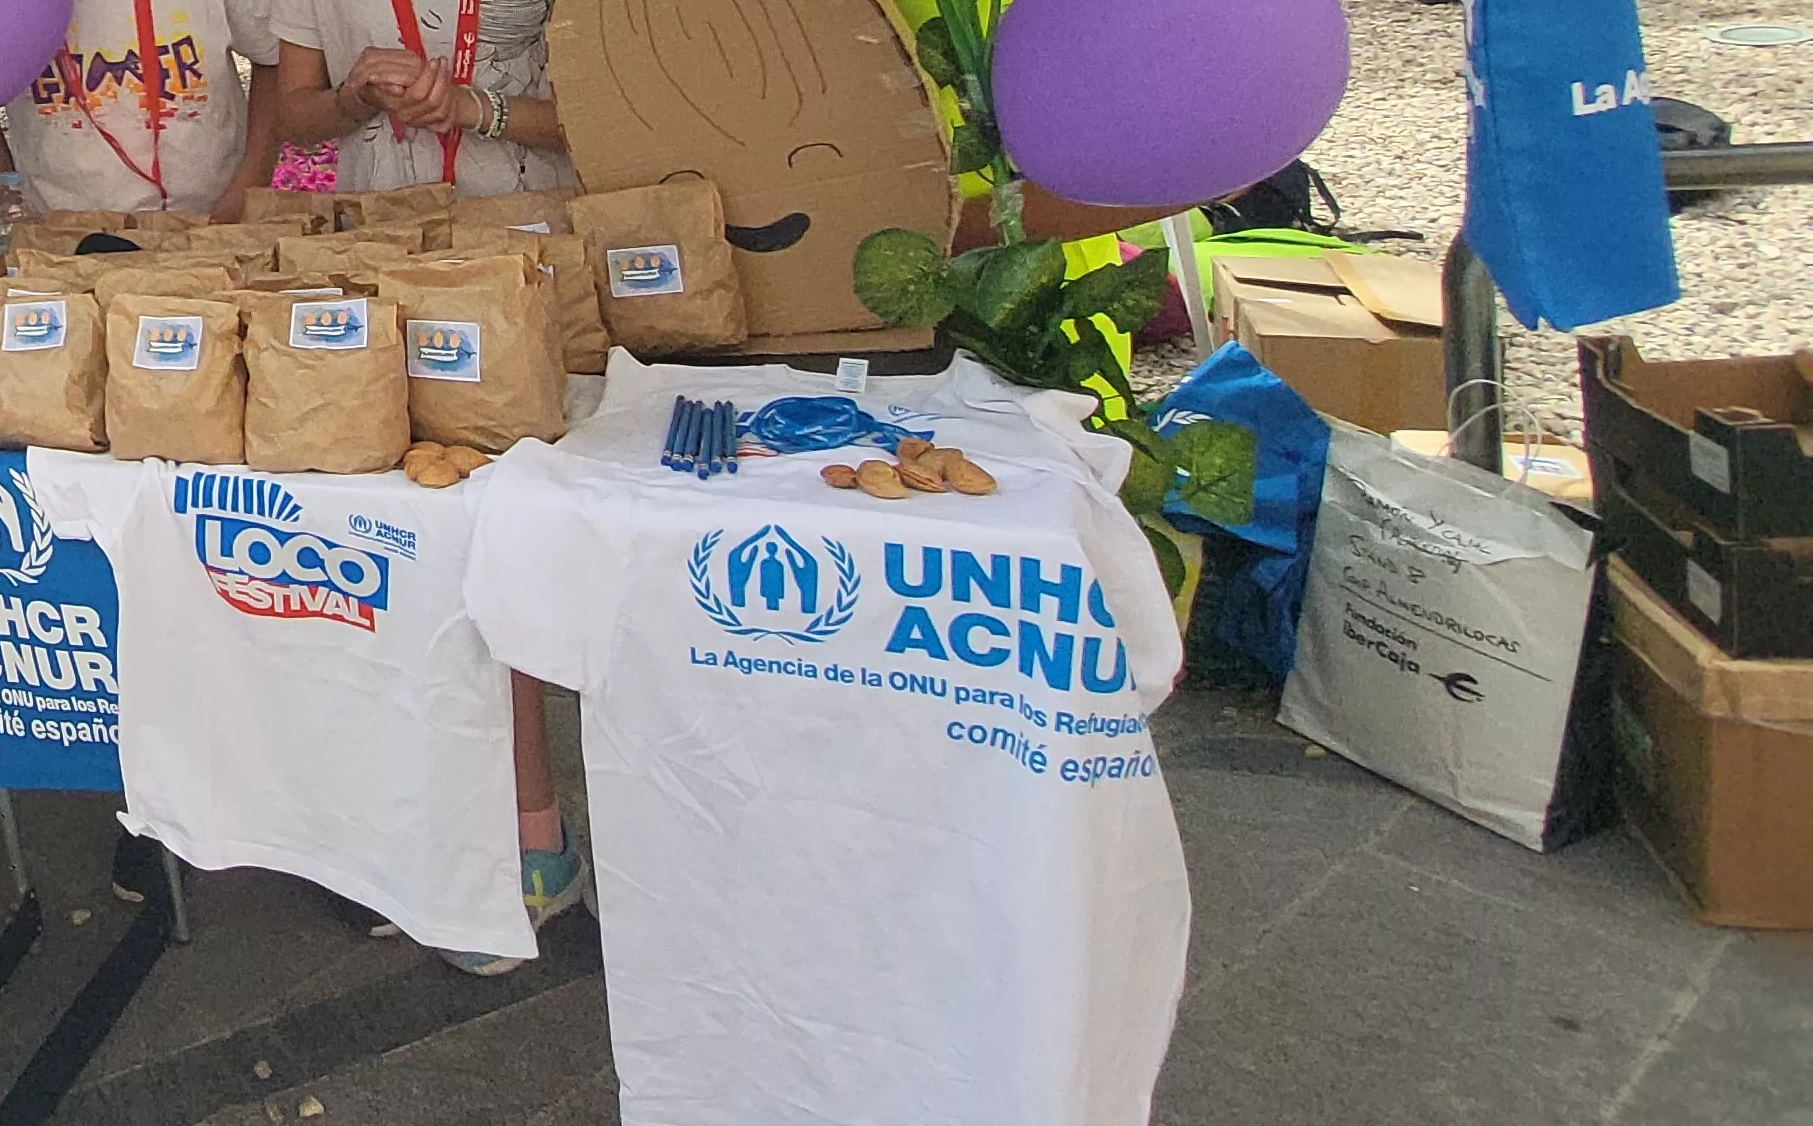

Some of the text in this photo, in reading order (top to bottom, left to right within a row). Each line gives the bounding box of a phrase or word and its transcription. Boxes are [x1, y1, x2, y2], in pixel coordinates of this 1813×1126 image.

[1571, 82, 1618, 116] La
[205, 519, 382, 597] LOCO
[374, 519, 417, 542] UNHCR
[208, 569, 371, 626] FESTIVAL
[884, 606, 1137, 695] ACNU
[1345, 601, 1418, 651] Fundación
[2, 689, 34, 708] ONU
[36, 696, 71, 711] para
[73, 696, 96, 713] los
[690, 646, 718, 667] La
[723, 650, 818, 680] Agencia
[824, 663, 855, 684] de
[860, 666, 883, 688] la
[888, 671, 948, 698] ONU
[954, 684, 1015, 709] para
[1019, 694, 1047, 727] los
[946, 720, 1048, 775] comité
